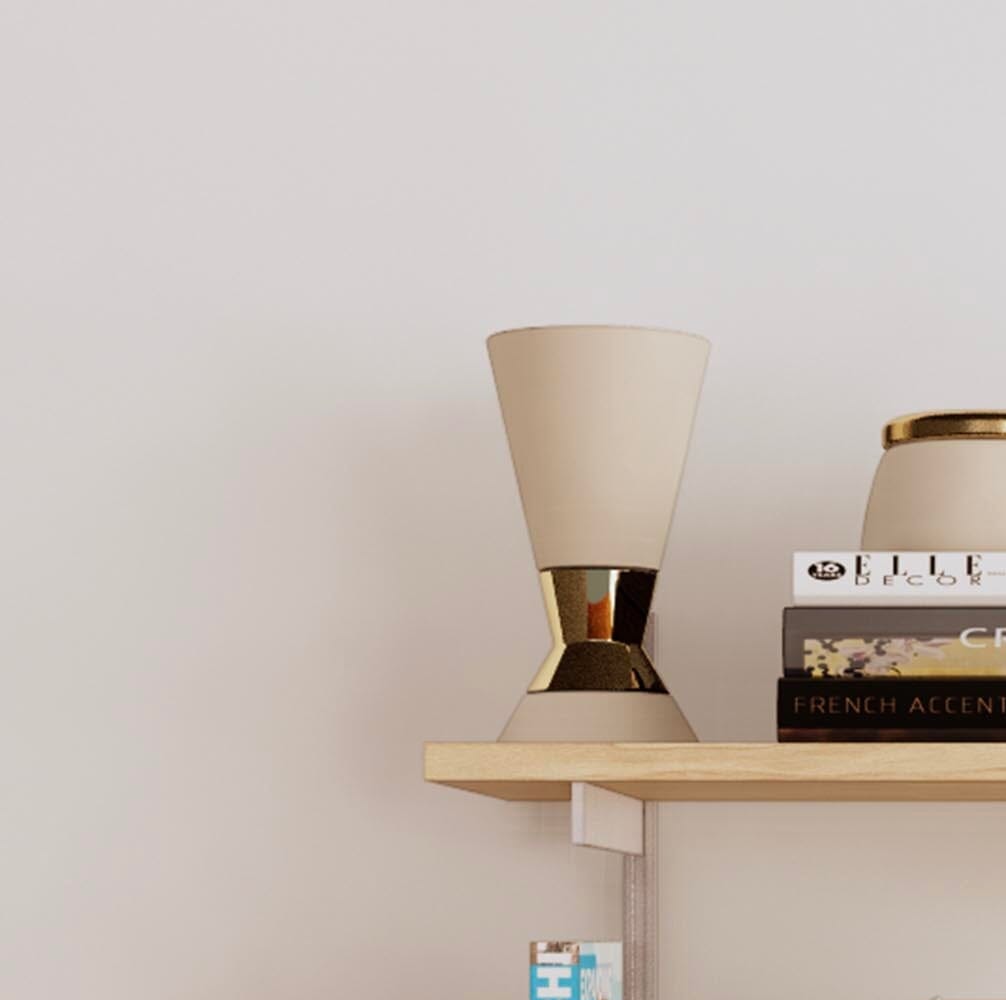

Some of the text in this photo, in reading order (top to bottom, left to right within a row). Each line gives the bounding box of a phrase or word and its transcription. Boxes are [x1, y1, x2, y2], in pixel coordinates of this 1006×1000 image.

[855, 554, 982, 575] ELLE
[855, 575, 982, 586] DECOR
[794, 696, 896, 714] FRENCH
